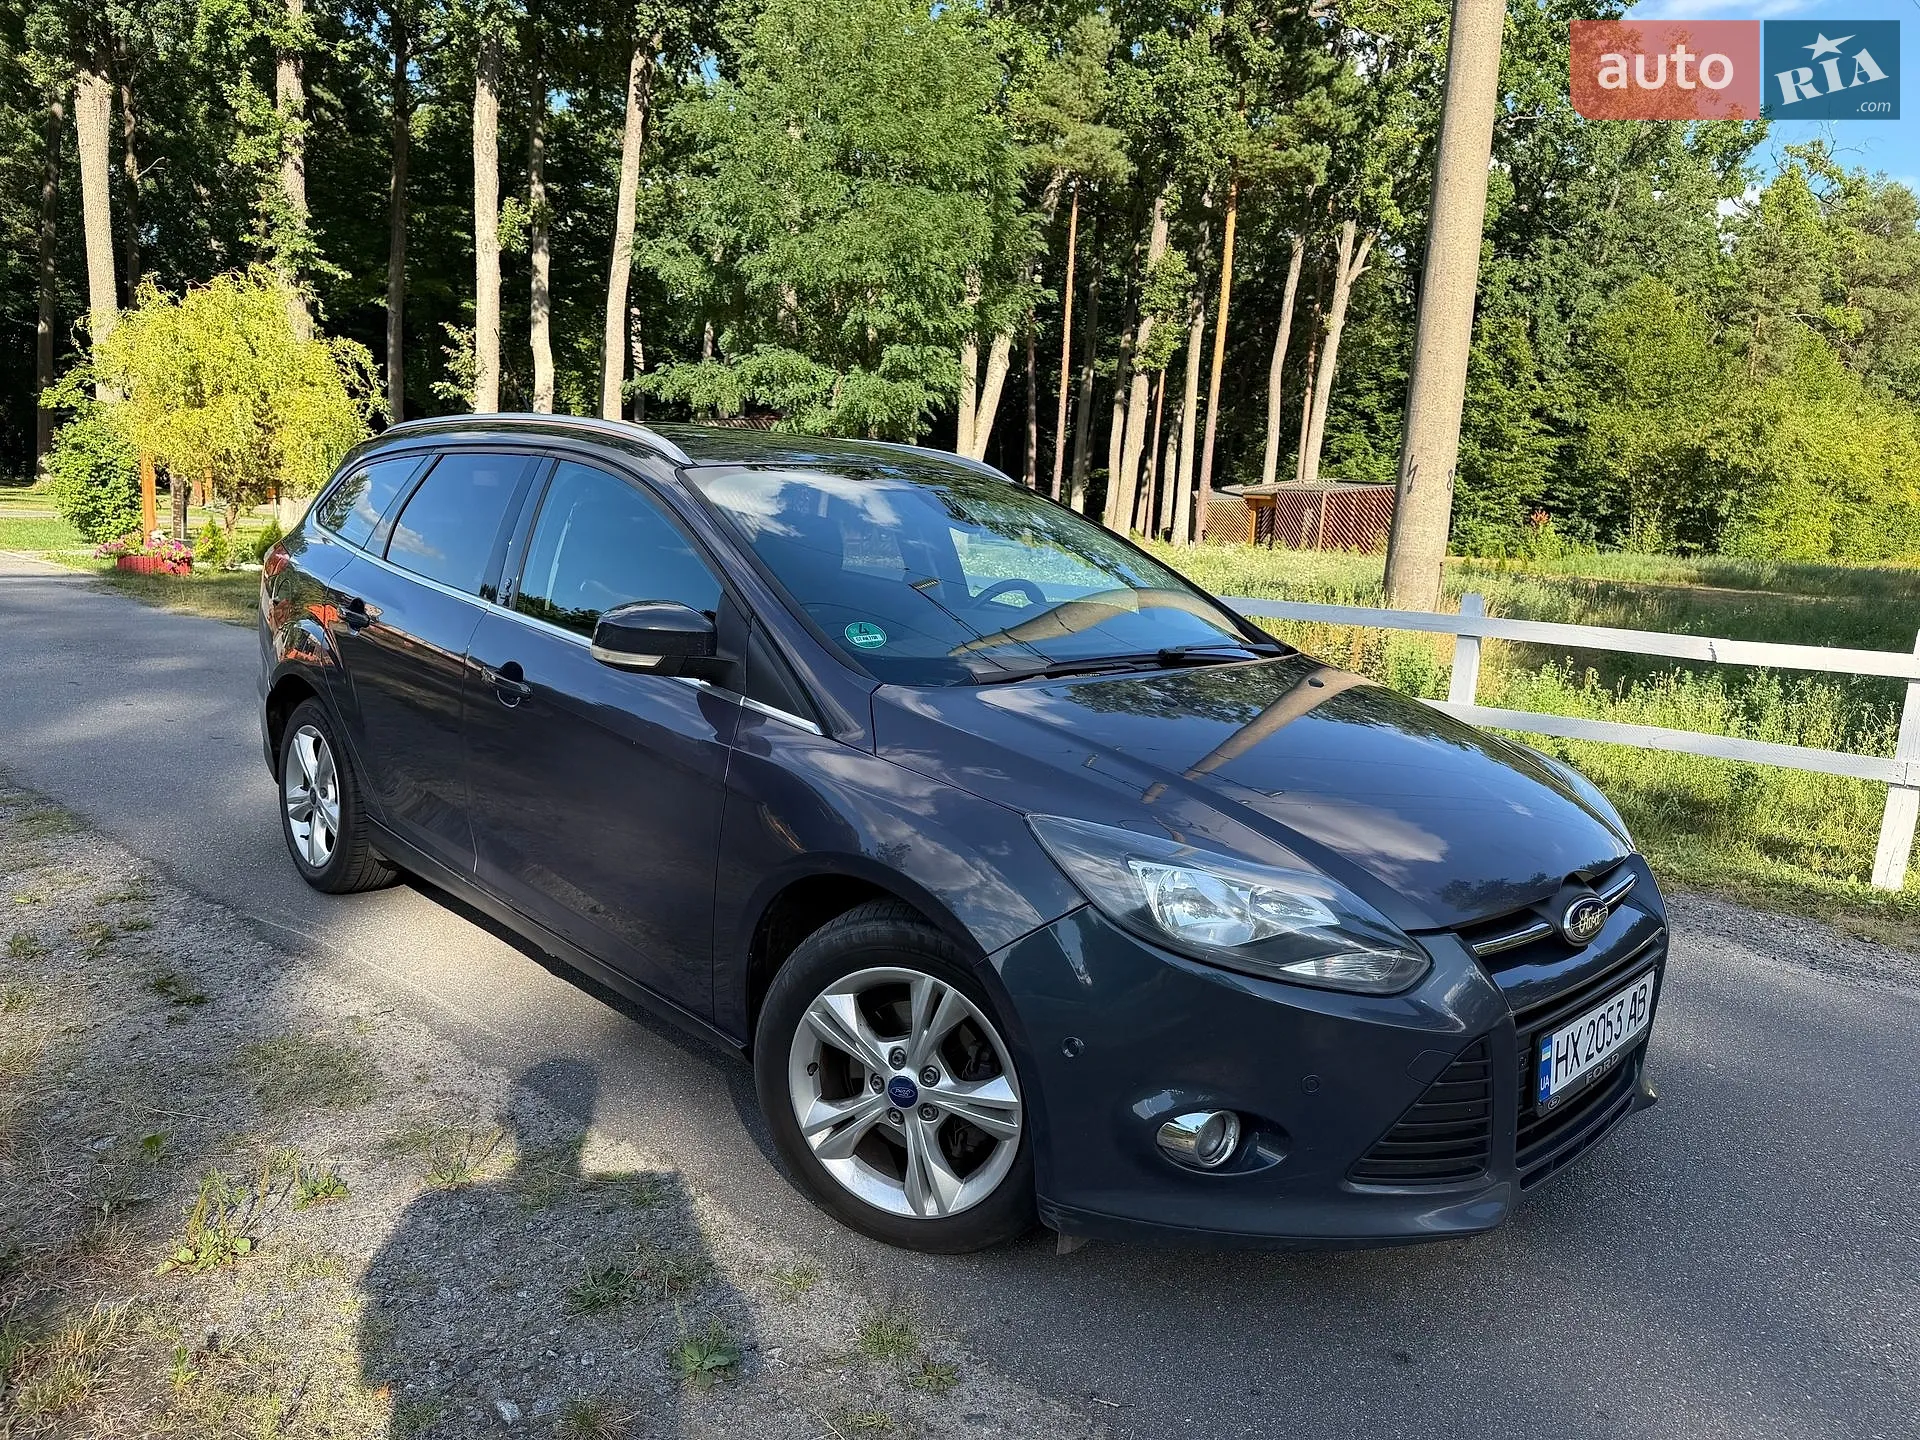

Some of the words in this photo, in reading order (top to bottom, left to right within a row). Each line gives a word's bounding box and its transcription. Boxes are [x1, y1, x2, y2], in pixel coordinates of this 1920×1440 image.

[1446, 469, 1453, 491] 8
[859, 623, 869, 635] 4
[1579, 905, 1602, 933] Ford
[1554, 1025, 1583, 1084] HX
[1585, 998, 1625, 1065] 2053
[1626, 983, 1648, 1033] AB
[1584, 1052, 1619, 1086] FORD
[1540, 1074, 1550, 1091] UA
